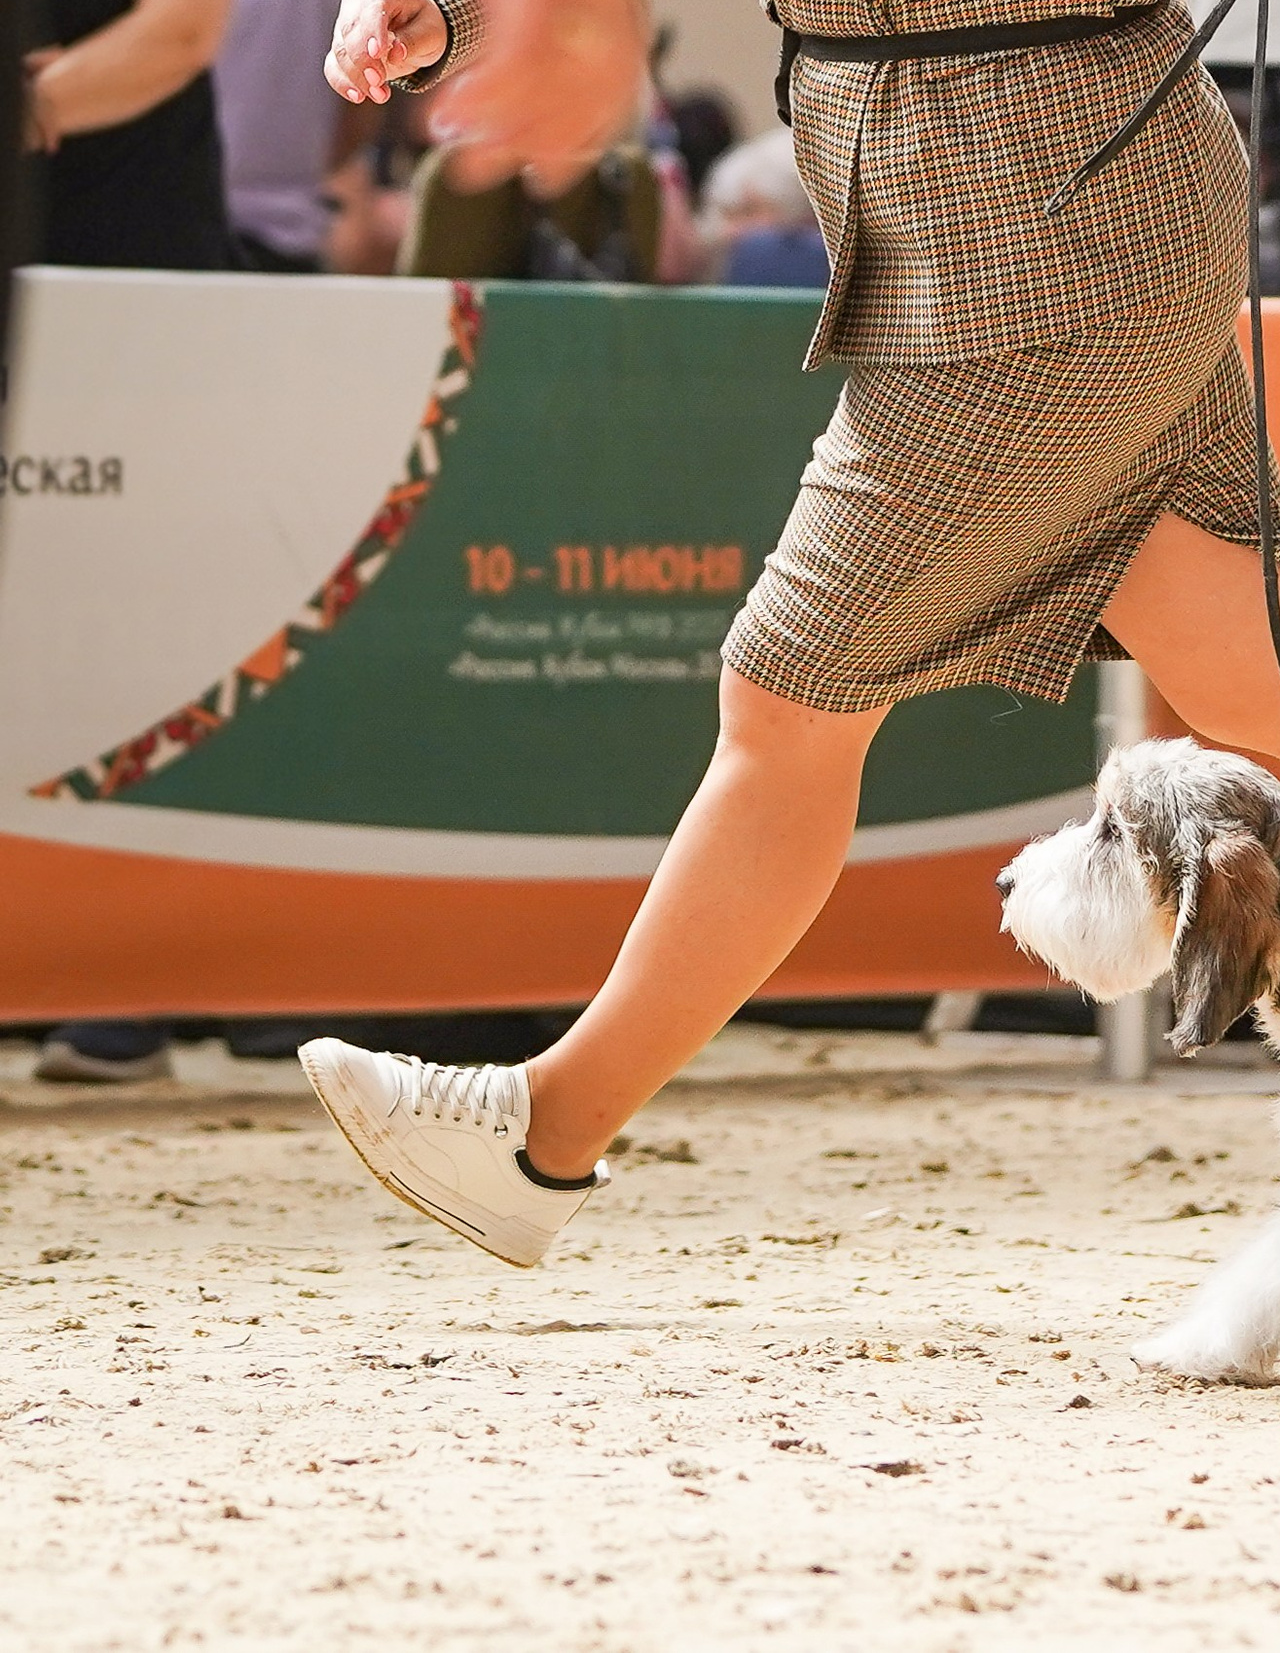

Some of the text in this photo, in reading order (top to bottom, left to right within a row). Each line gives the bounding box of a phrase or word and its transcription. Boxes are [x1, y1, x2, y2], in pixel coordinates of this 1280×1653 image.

[465, 545, 514, 593] 10
[555, 545, 594, 592] 11
[604, 545, 743, 592] ИЮНЯ
